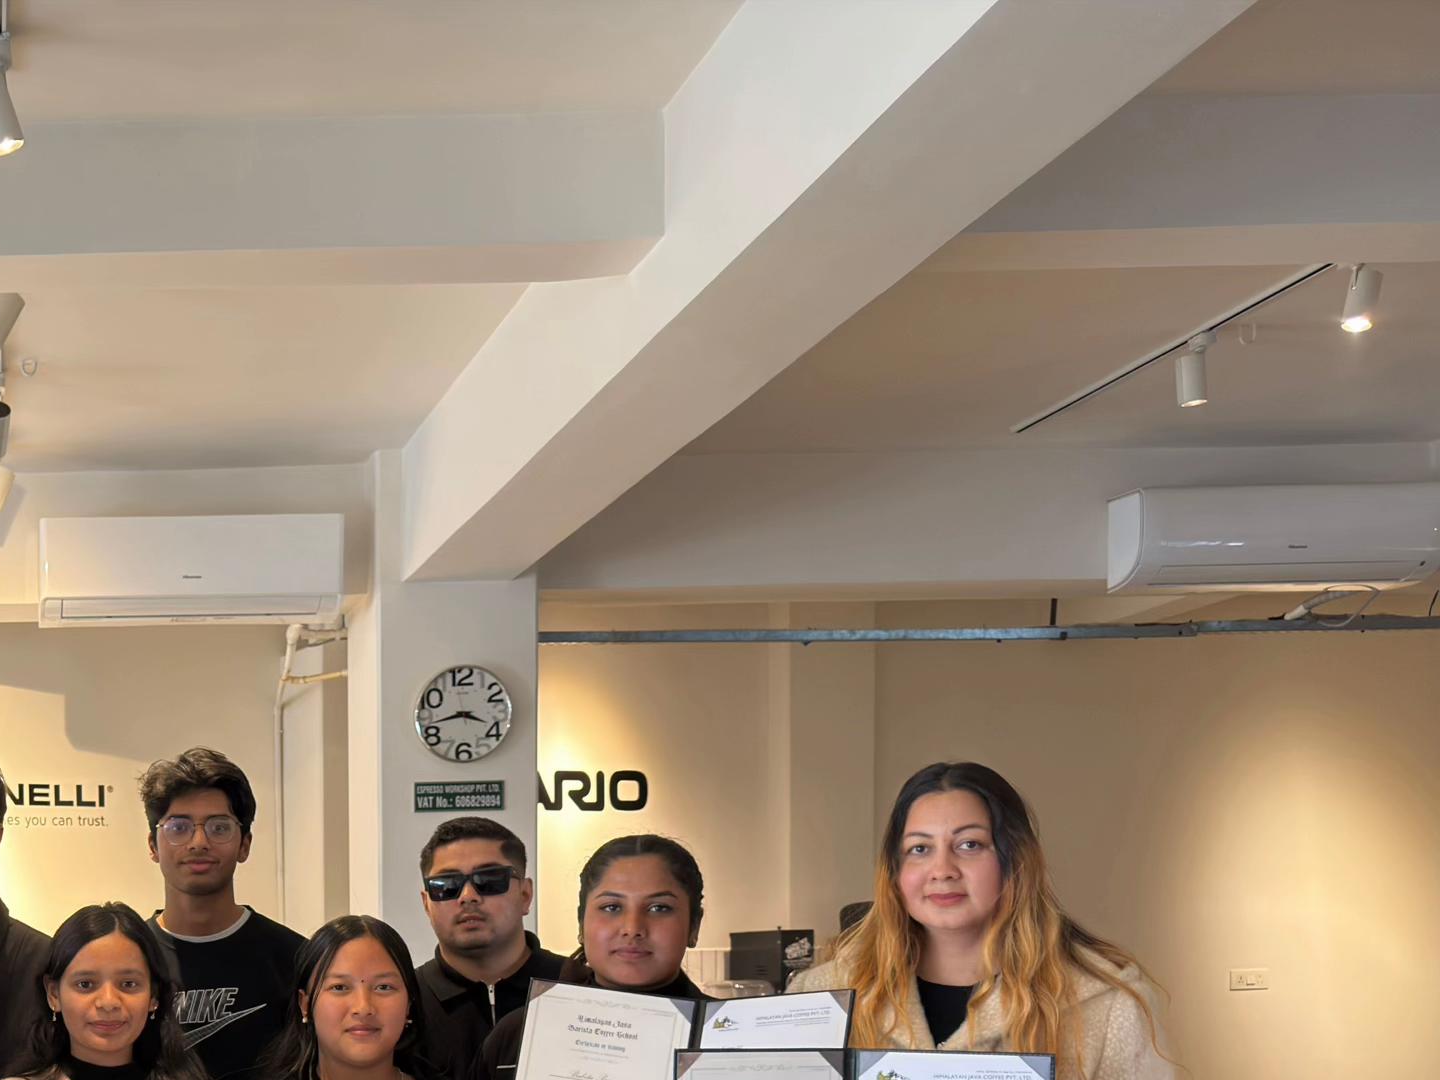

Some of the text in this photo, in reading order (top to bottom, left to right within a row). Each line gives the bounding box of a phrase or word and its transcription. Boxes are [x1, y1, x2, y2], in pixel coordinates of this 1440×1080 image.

[449, 668, 473, 687] 12
[487, 682, 504, 703] 2
[424, 726, 440, 746] 8
[485, 721, 502, 741] 4
[455, 742, 472, 760] 6
[444, 785, 475, 793] WORKSHOP
[417, 797, 434, 808] VAT
[25, 815, 48, 828] you
[52, 817, 73, 827] can
[78, 815, 109, 827] trust.
[175, 987, 239, 1024] NIKE
